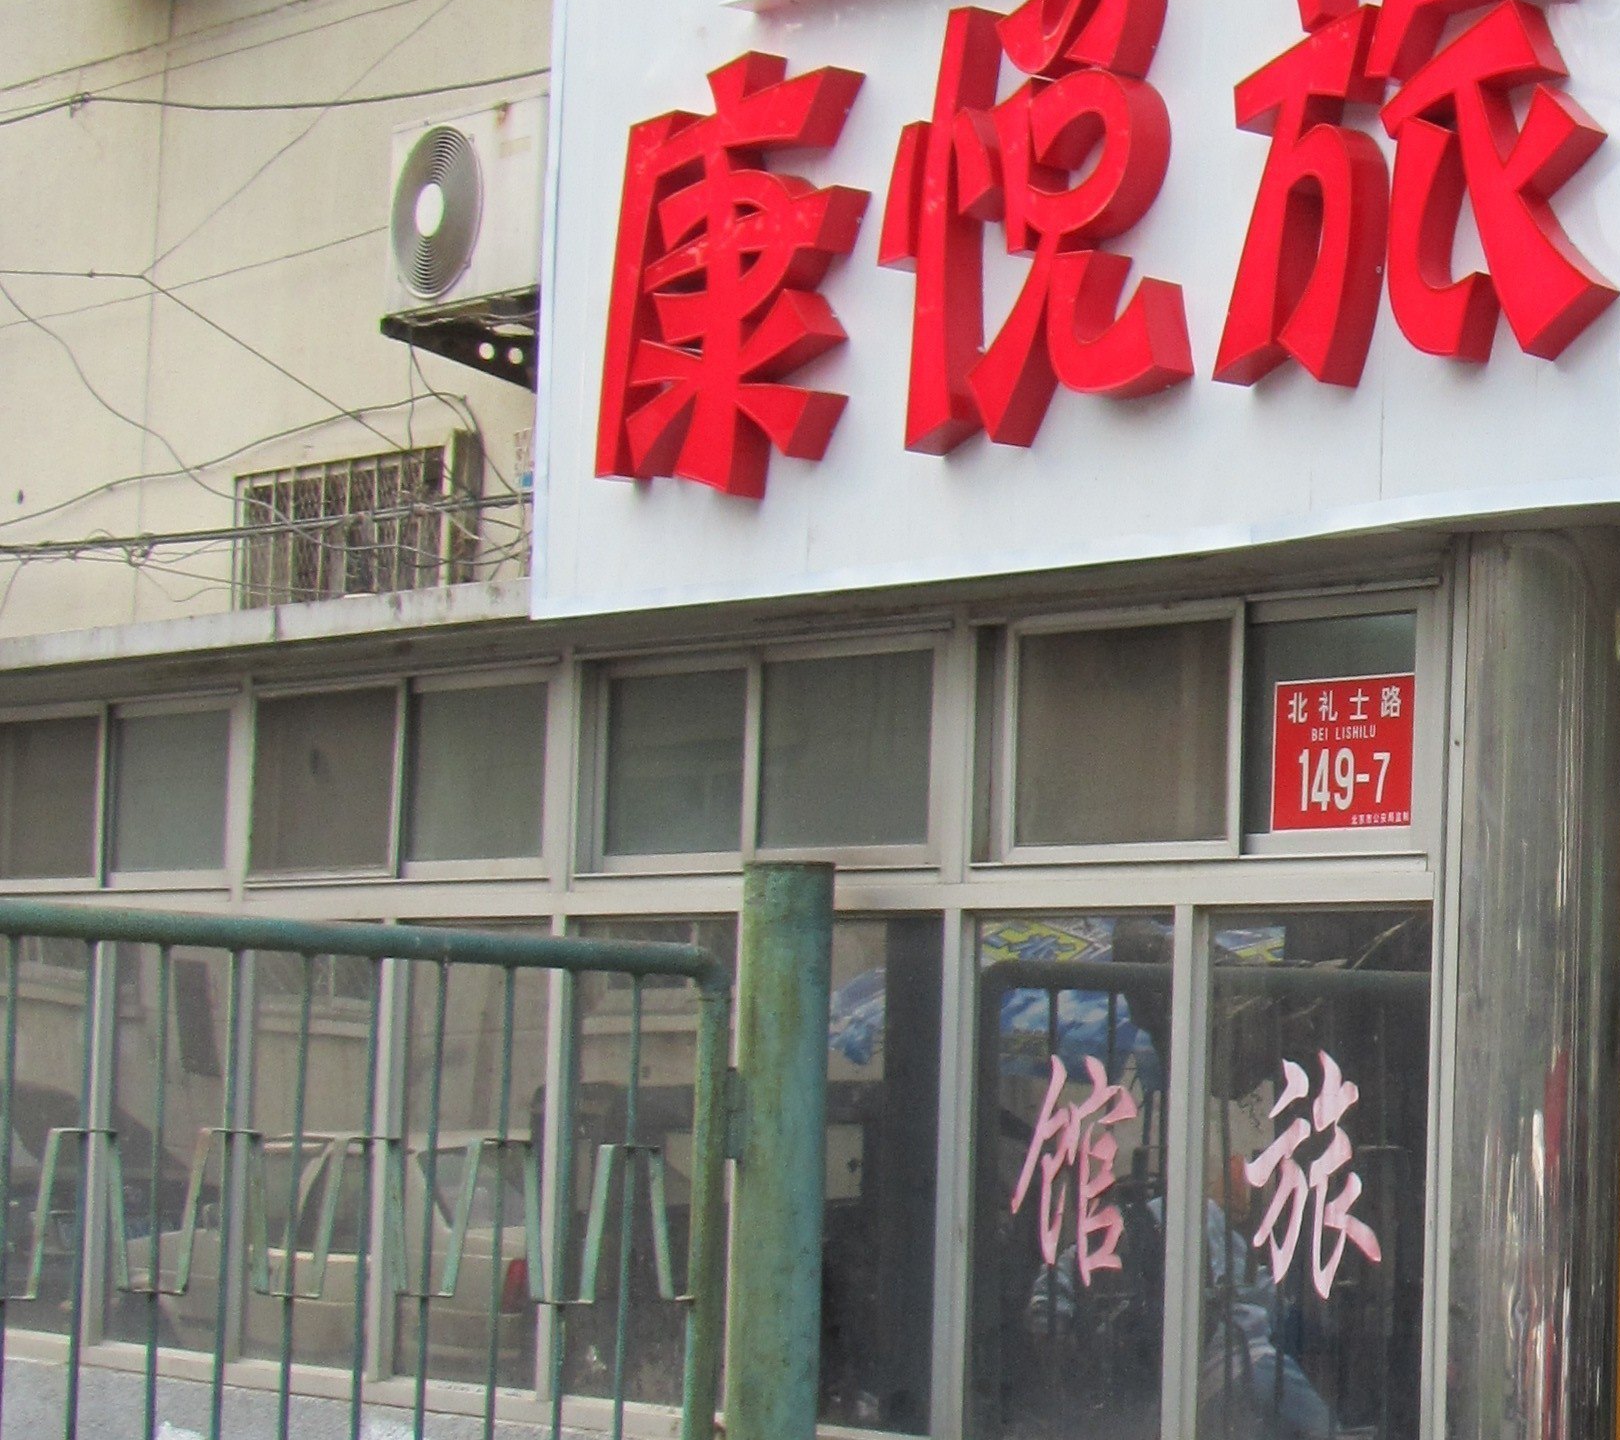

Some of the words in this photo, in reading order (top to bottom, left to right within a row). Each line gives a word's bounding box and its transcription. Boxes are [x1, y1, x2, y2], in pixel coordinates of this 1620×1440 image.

[1287, 685, 1402, 724] 北礼士路
[1310, 726, 1329, 743] BEI
[1335, 724, 1377, 741] LISHILU
[1298, 746, 1392, 812] 149-7
[1010, 1053, 1138, 1288] 馆
[1243, 1049, 1382, 1301] 旅
